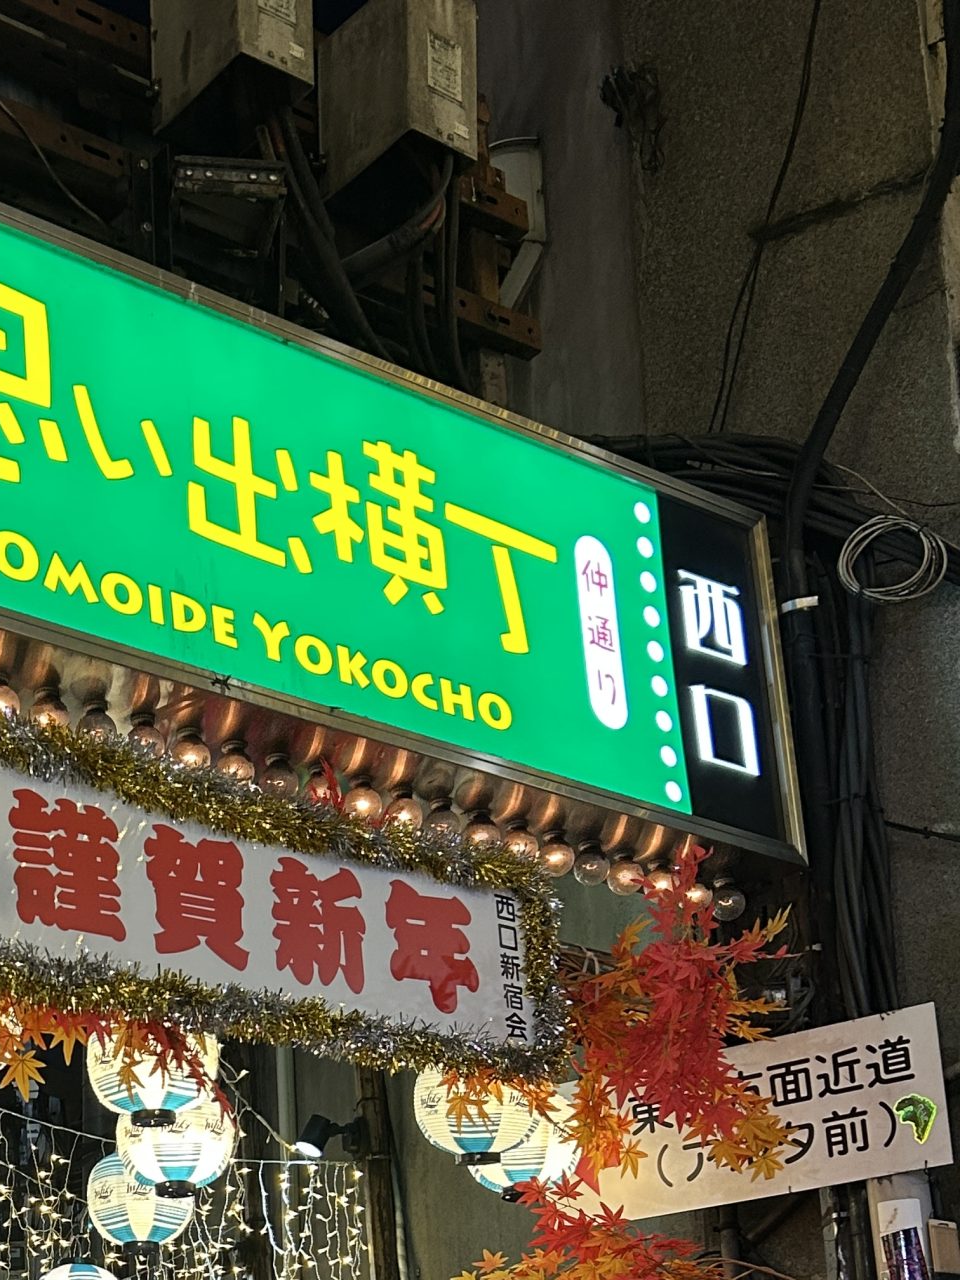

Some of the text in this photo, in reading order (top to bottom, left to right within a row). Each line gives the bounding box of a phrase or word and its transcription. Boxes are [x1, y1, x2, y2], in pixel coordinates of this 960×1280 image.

[252, 611, 514, 732] YOKOCHO
[580, 558, 622, 708] 仲通り
[676, 568, 761, 779] 西口
[8, 788, 479, 1014] 謹賀新年
